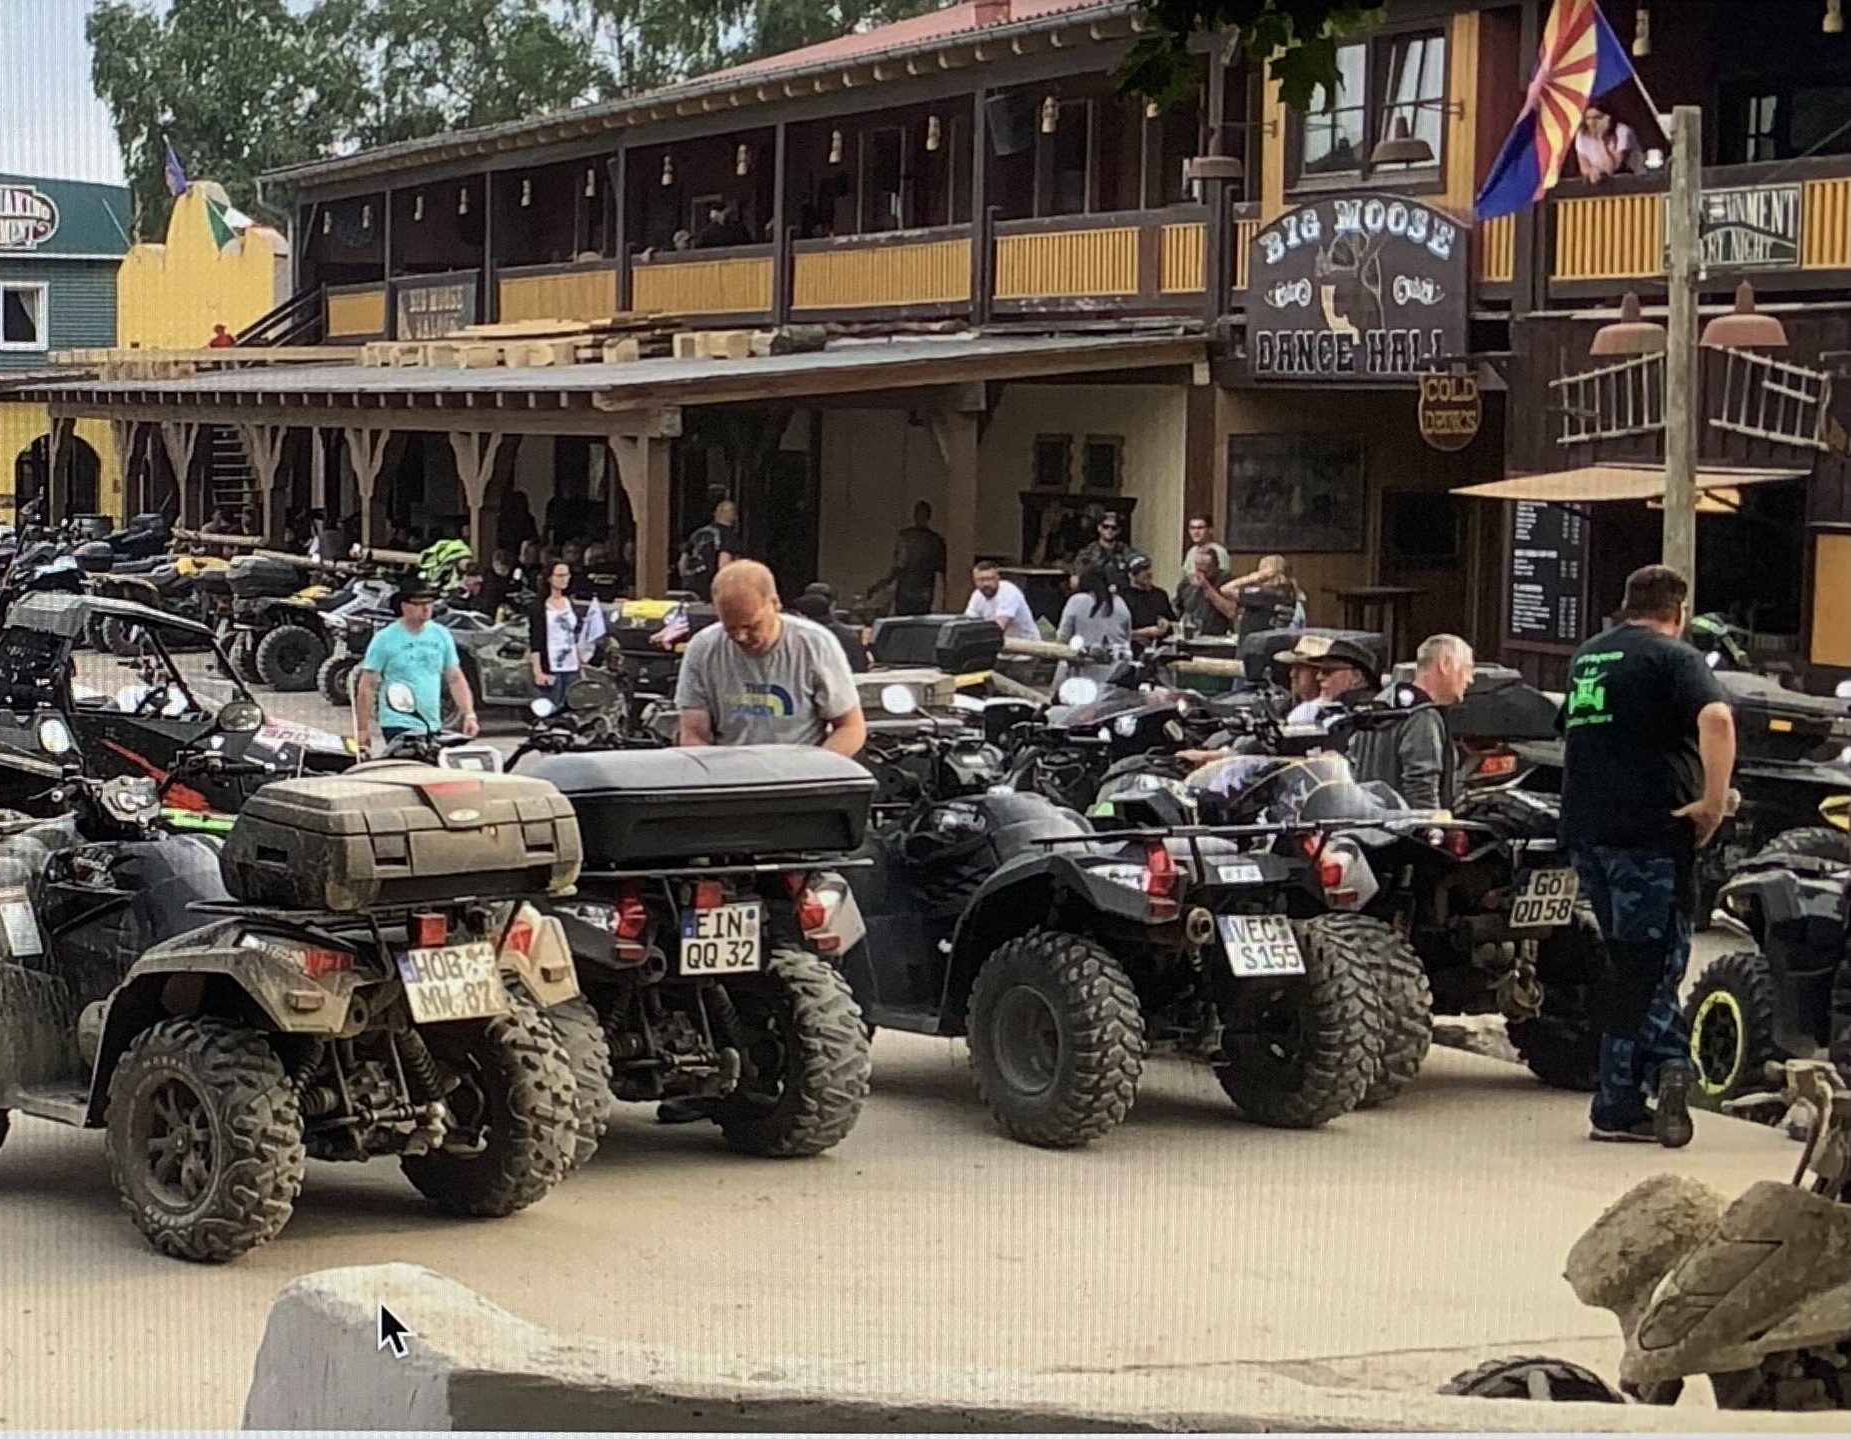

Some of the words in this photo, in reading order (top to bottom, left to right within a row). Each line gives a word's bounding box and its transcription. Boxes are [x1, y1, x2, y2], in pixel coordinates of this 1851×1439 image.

[1258, 208, 1321, 264] BIG
[1333, 199, 1456, 261] MOOSE
[1256, 329, 1355, 374] DANCE
[1366, 328, 1450, 375] HALL
[1425, 377, 1478, 401] COLD
[696, 911, 743, 940] EIN
[1232, 918, 1277, 943] VEC
[687, 942, 719, 969] QQ
[725, 940, 755, 968] 32
